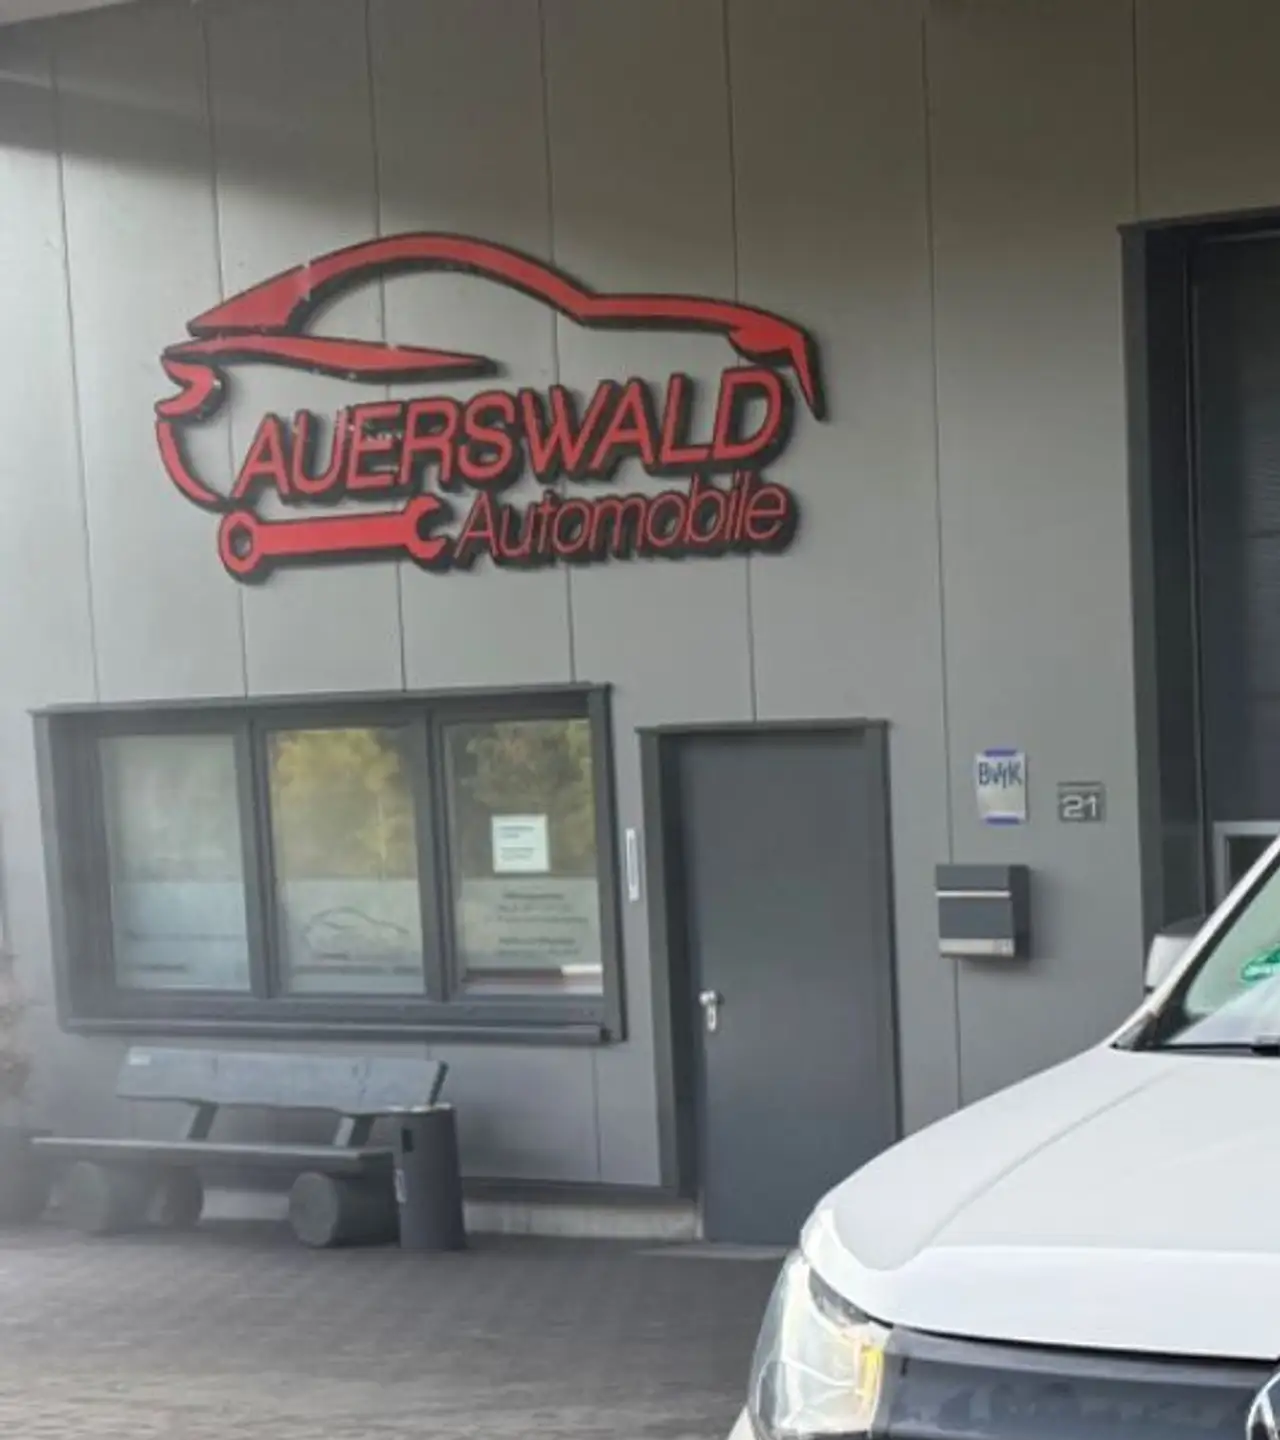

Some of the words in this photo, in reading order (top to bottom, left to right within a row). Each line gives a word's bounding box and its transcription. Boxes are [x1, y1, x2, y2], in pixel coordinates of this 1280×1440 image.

[233, 367, 785, 503] AUERSWALD
[455, 474, 792, 561] Automobile
[1062, 795, 1097, 818] 21
